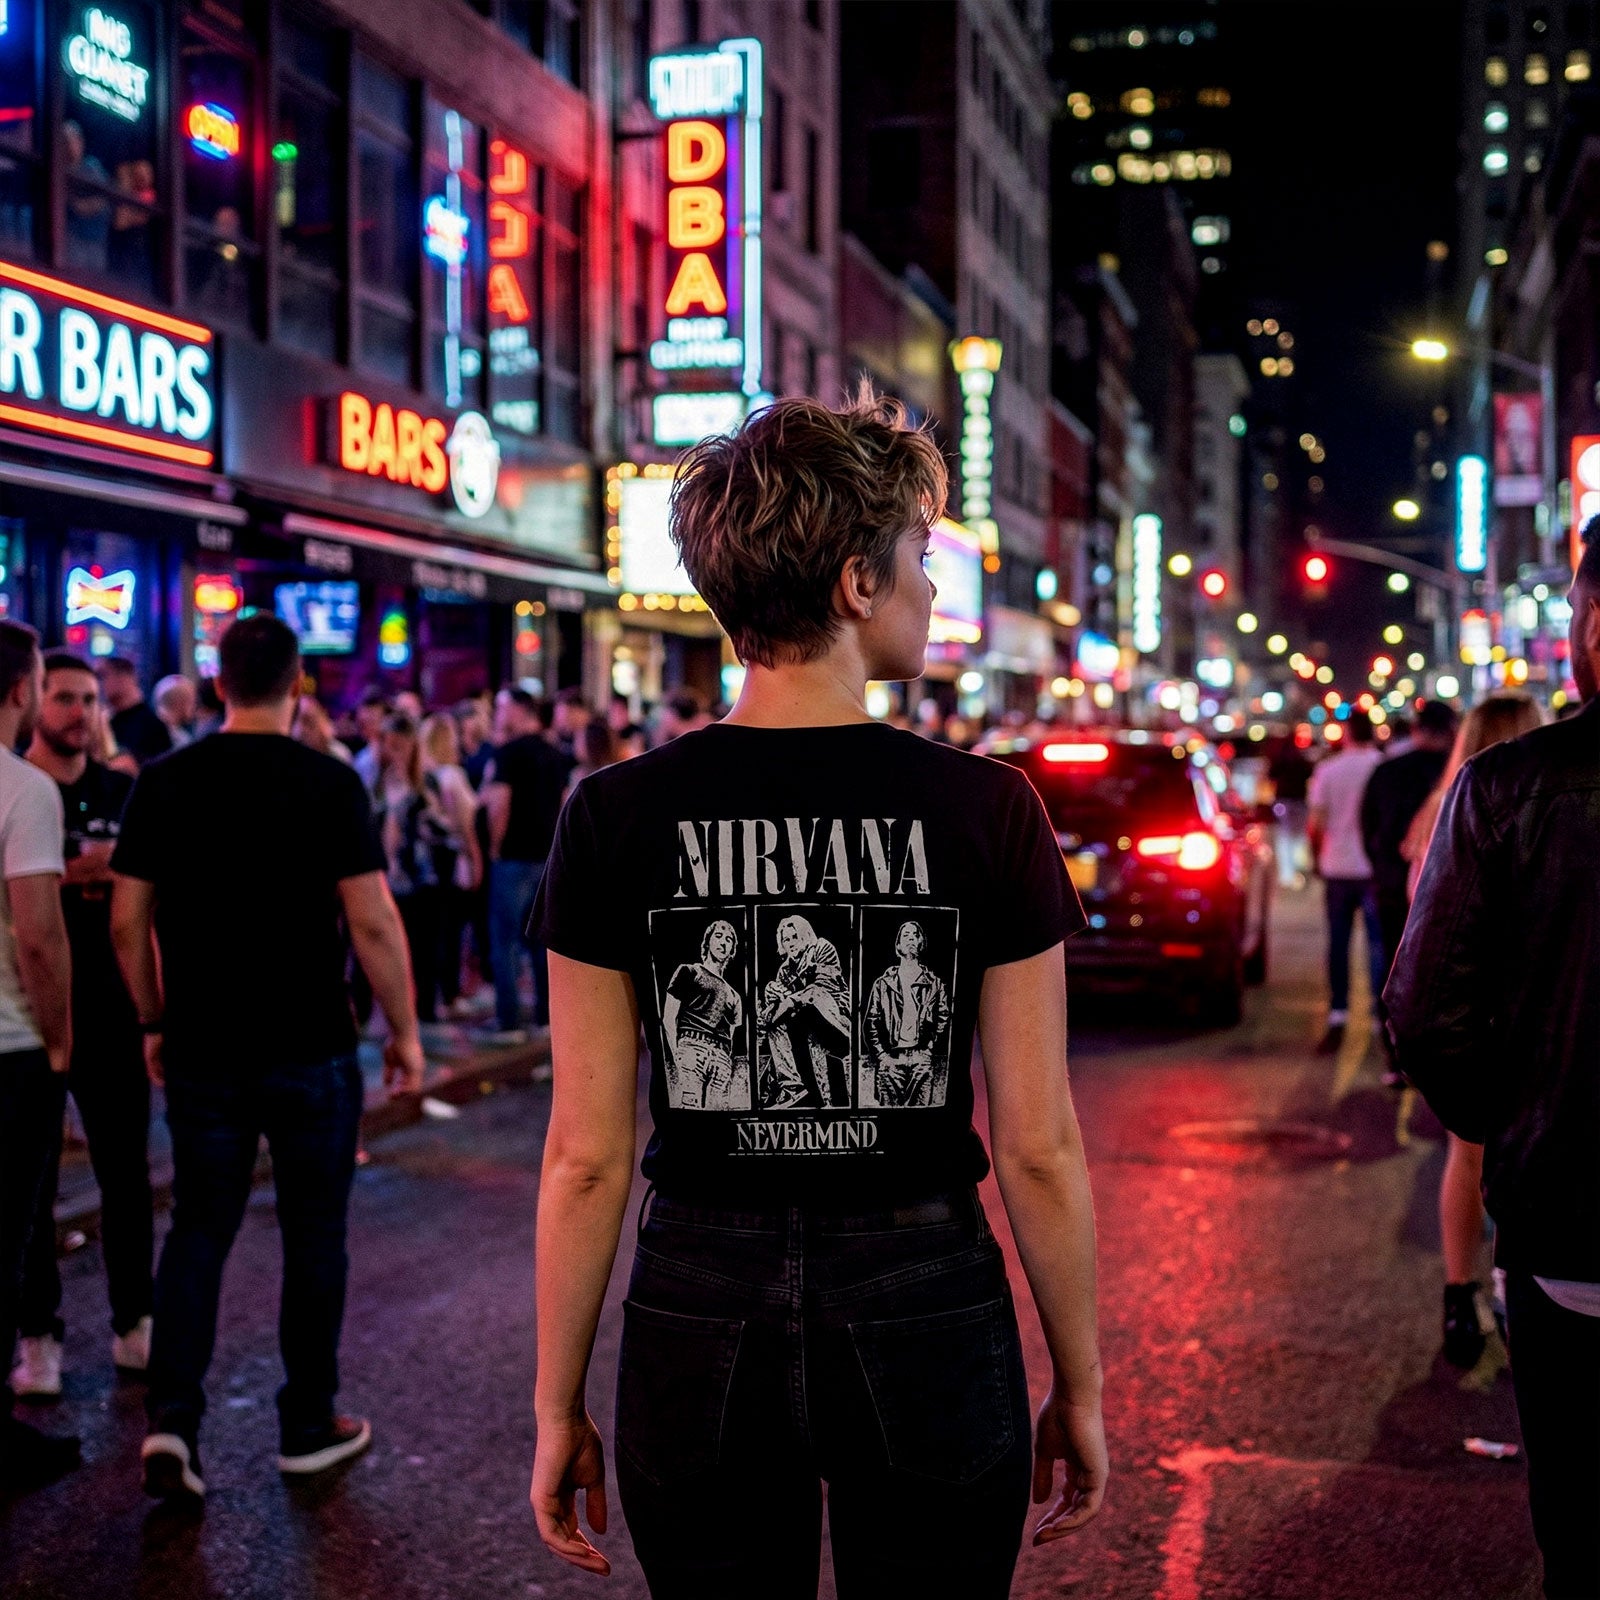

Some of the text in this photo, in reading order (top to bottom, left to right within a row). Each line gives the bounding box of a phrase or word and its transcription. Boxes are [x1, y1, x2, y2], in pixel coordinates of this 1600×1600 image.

[666, 120, 728, 315] DBA
[60, 307, 214, 441] BARS
[340, 391, 449, 494] BARS
[673, 817, 931, 898] NIRVANA
[736, 1120, 878, 1150] NEVERMIND
